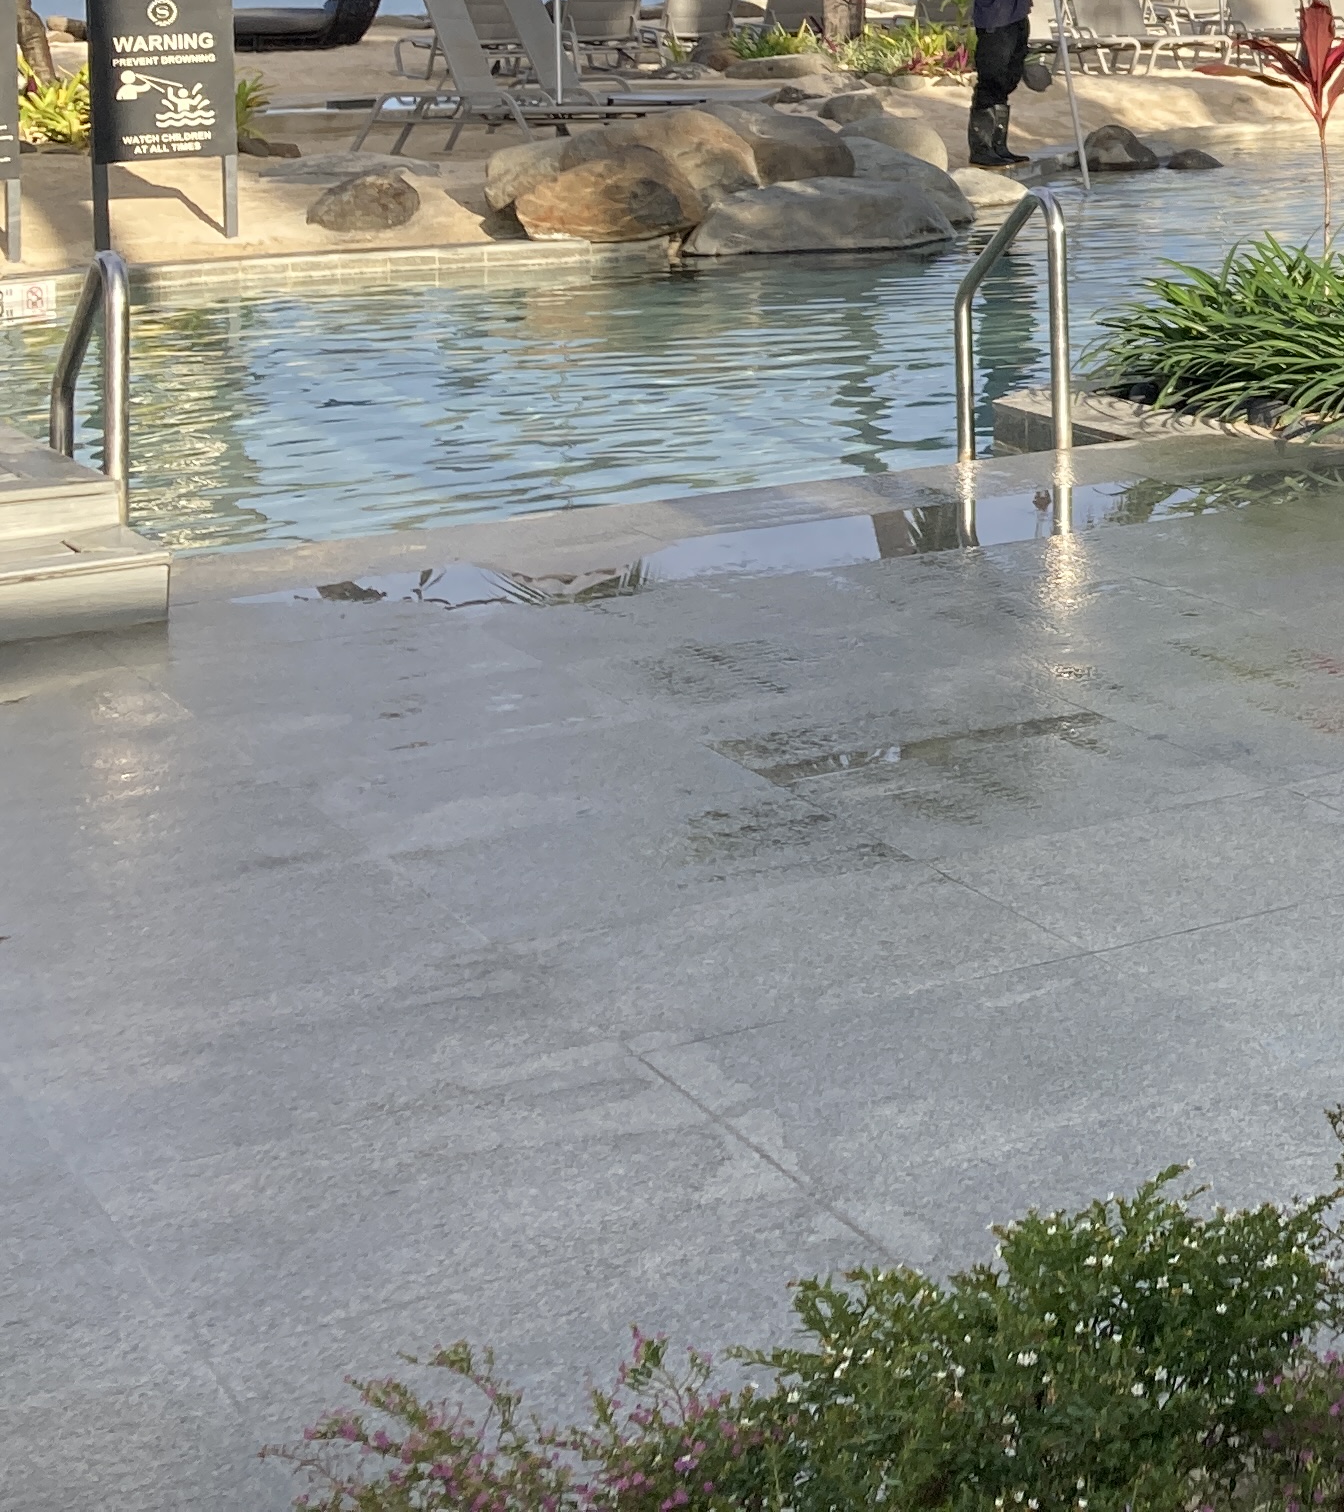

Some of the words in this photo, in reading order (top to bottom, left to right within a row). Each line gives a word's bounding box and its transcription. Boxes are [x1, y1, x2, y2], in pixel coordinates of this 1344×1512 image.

[112, 32, 214, 53] WARNING
[112, 56, 160, 67] PREVENT
[160, 53, 216, 65] DROWNING
[122, 134, 160, 145] WATCH
[161, 131, 212, 143] CHILDREN
[133, 145, 149, 155] AT
[149, 144, 170, 154] ALL
[171, 141, 201, 152] TIMES
